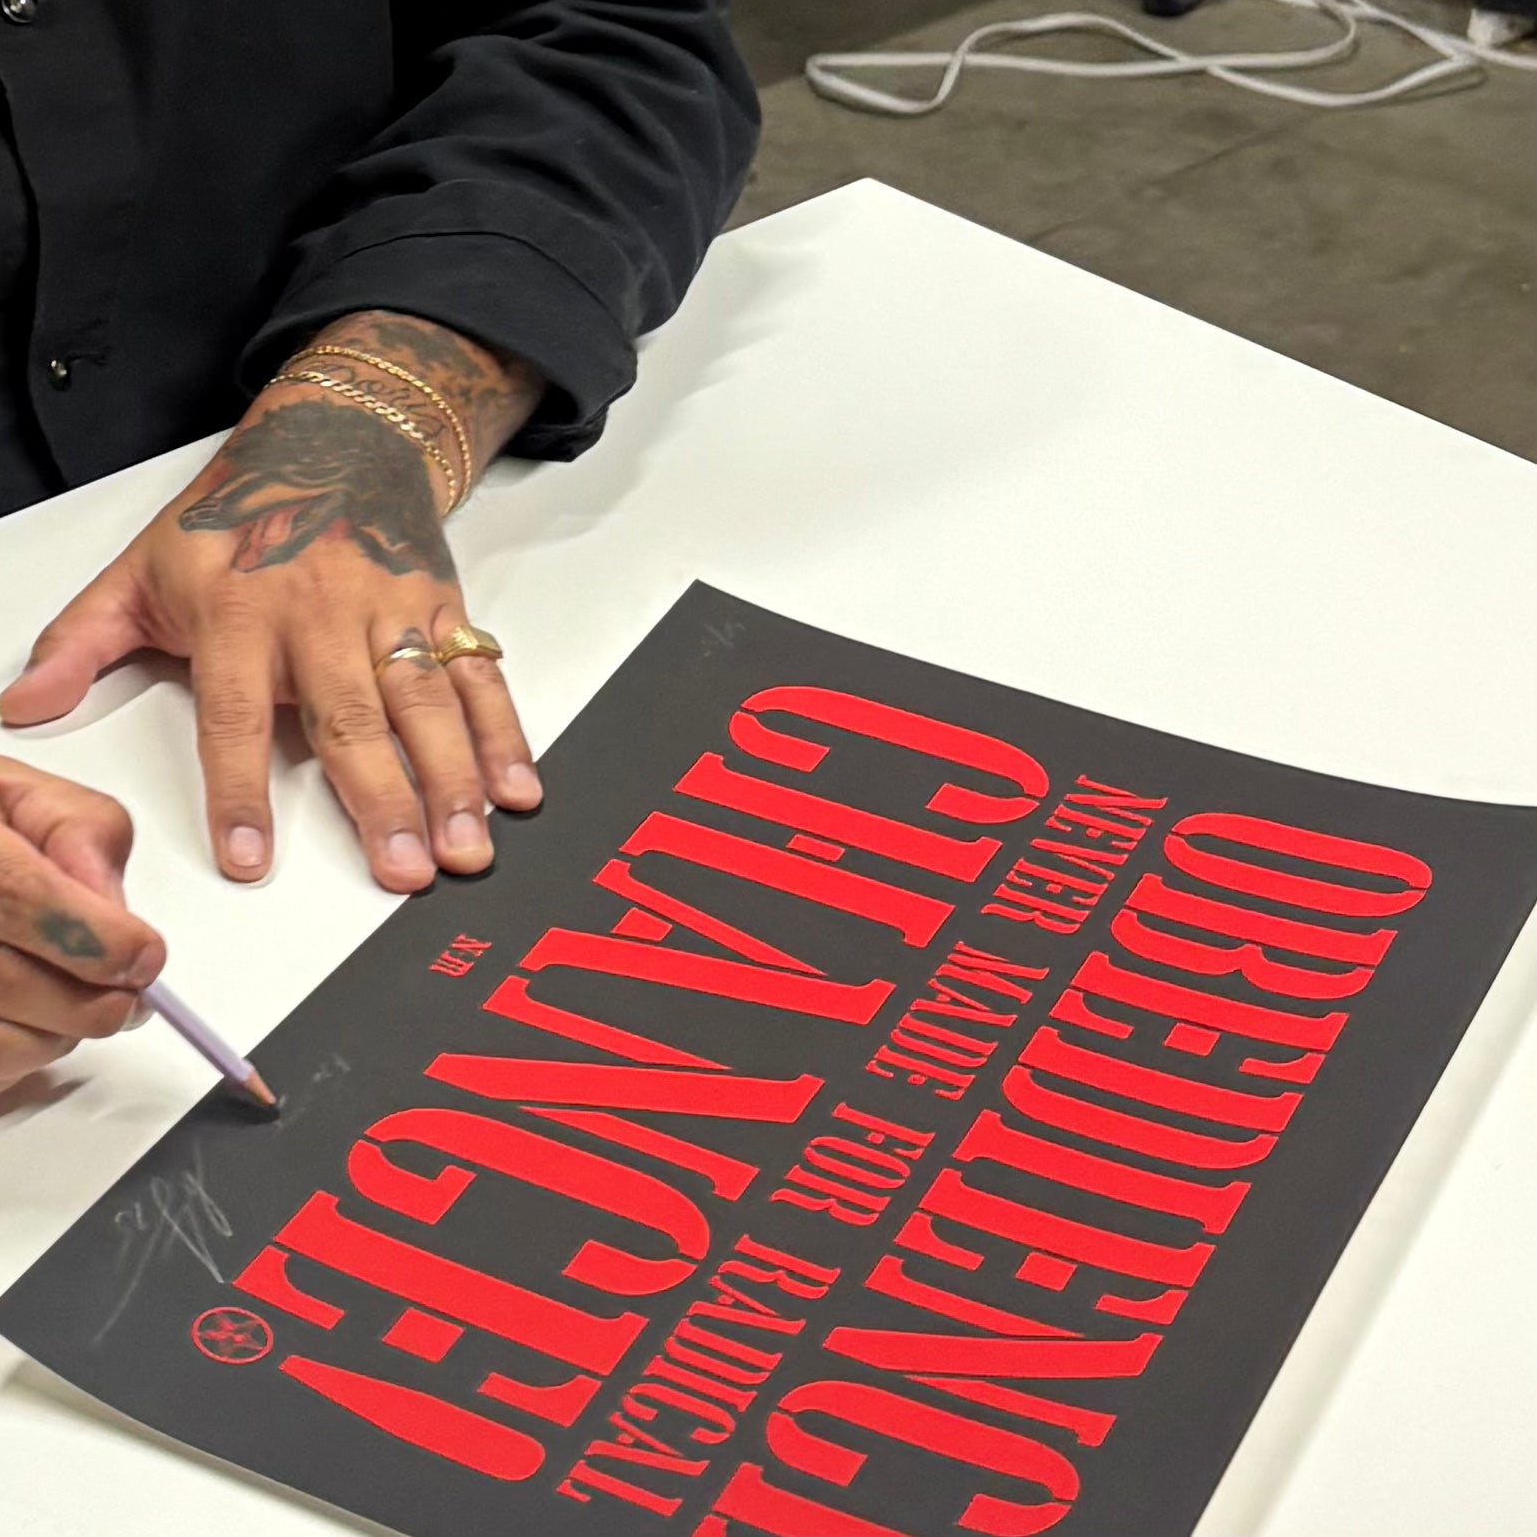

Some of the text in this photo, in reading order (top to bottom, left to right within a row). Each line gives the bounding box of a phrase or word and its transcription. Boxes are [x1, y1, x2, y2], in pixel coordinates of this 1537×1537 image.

[229, 684, 1051, 1484] CHANGE!
[554, 774, 1169, 1519] NEVER MADE FOR RADICAL
